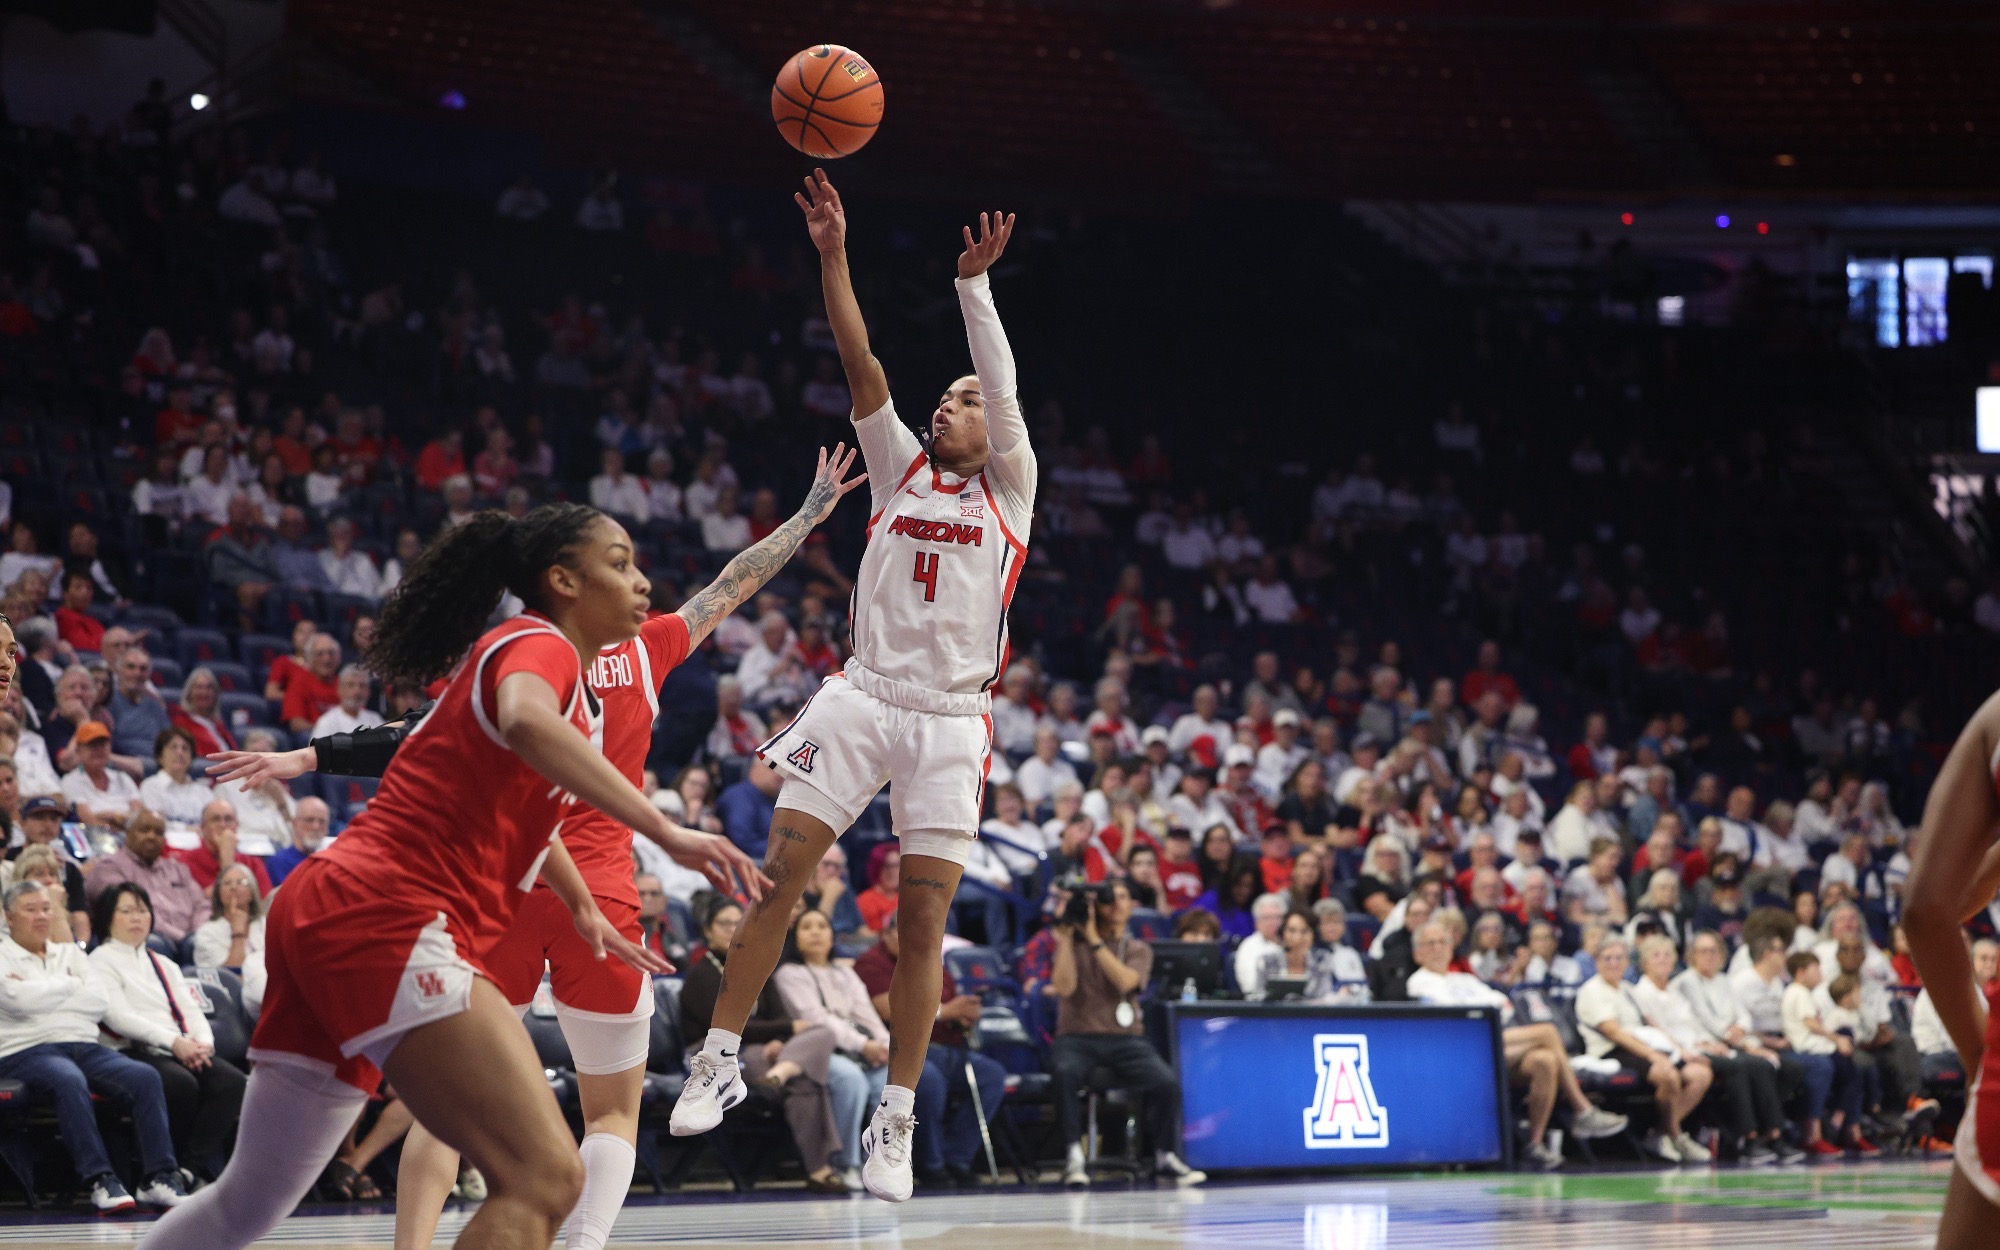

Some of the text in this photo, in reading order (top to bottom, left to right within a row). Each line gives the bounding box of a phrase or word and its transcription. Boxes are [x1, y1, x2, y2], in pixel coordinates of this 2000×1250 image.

[887, 515, 983, 547] ARIZONA
[913, 551, 939, 602] 4
[787, 740, 819, 773] A
[1303, 1033, 1389, 1149] A
